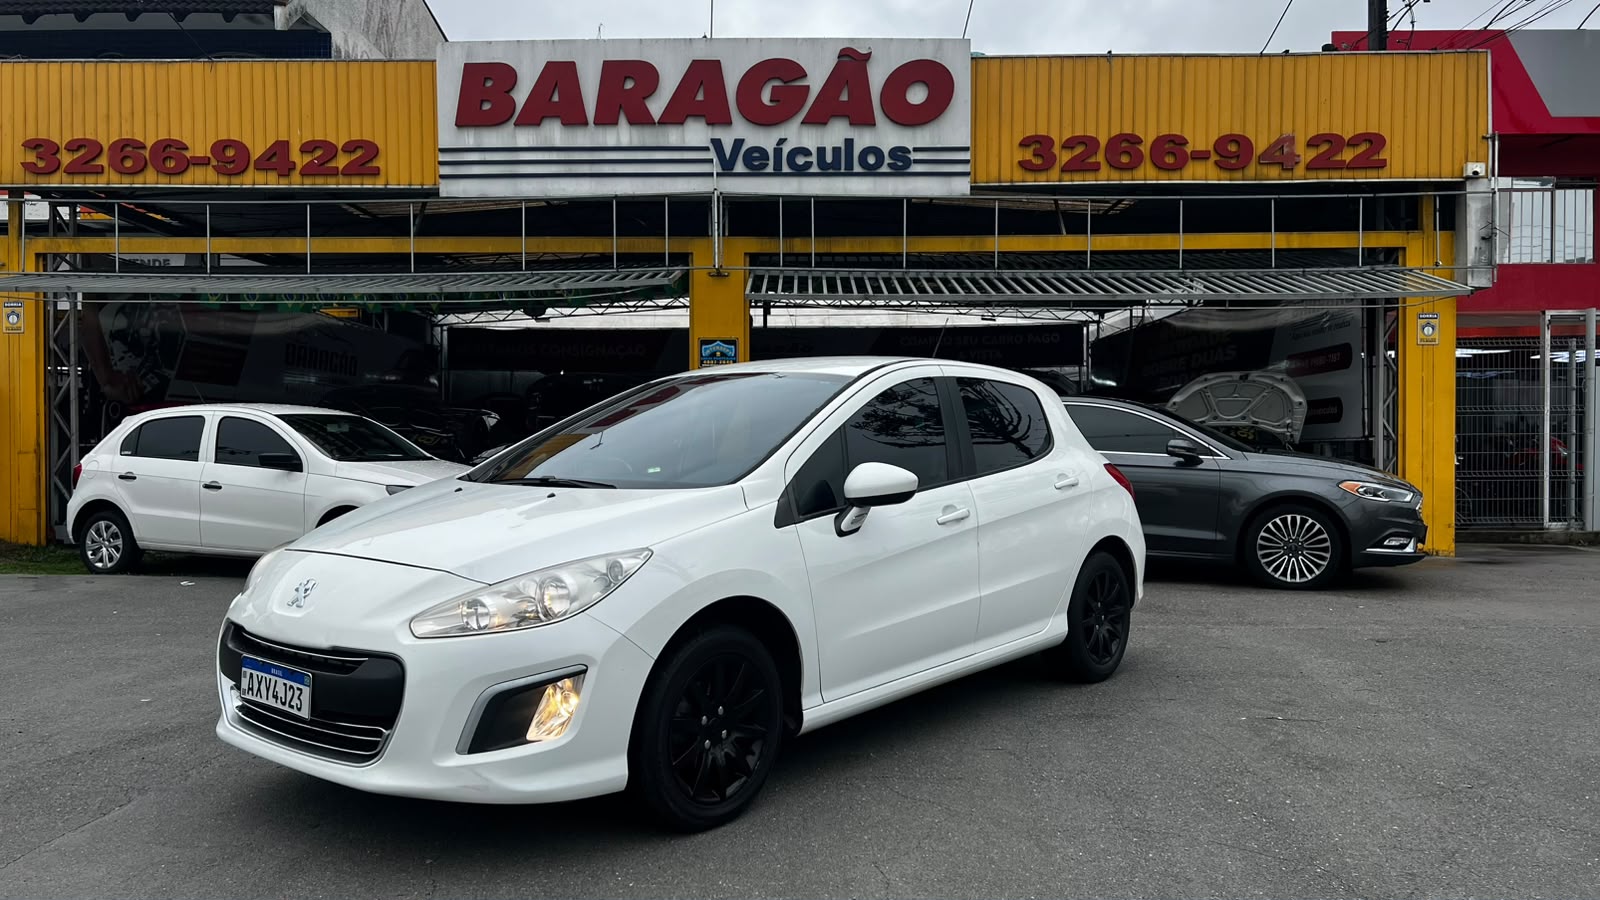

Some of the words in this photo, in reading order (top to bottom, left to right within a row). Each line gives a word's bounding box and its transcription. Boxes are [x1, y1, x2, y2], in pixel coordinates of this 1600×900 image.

[456, 48, 954, 126] BARAGÃO
[21, 137, 380, 176] 3266-9422
[711, 138, 913, 172] Veículos
[1018, 132, 1387, 172] 3266-9422
[247, 671, 303, 712] AXY4J23
